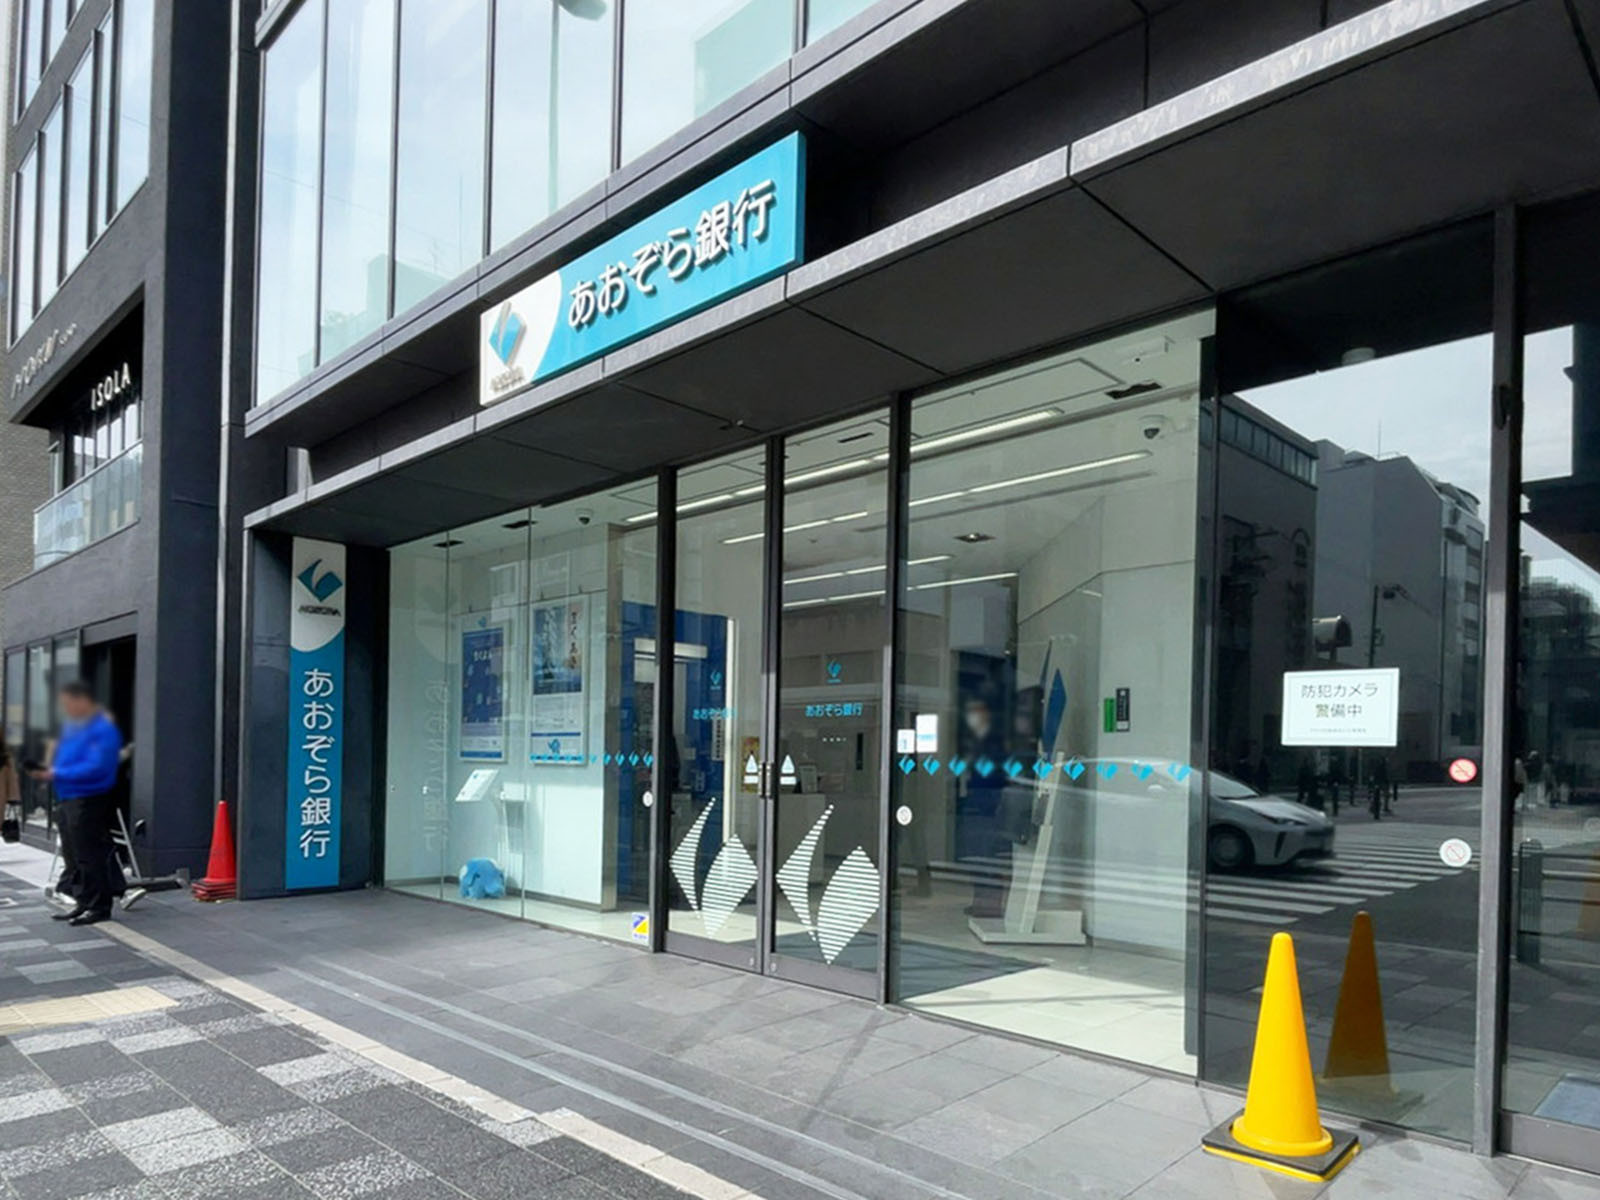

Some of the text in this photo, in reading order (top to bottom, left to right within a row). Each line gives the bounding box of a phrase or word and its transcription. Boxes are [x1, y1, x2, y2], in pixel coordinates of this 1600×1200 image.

[568, 179, 775, 328] あおぞら銀行
[91, 362, 131, 411] ISOLA
[1301, 682, 1379, 699] 防犯カメラ
[805, 702, 863, 718] あおぞら銀行
[1315, 703, 1363, 719] 警備中
[300, 667, 334, 859] あおぞら銀行
